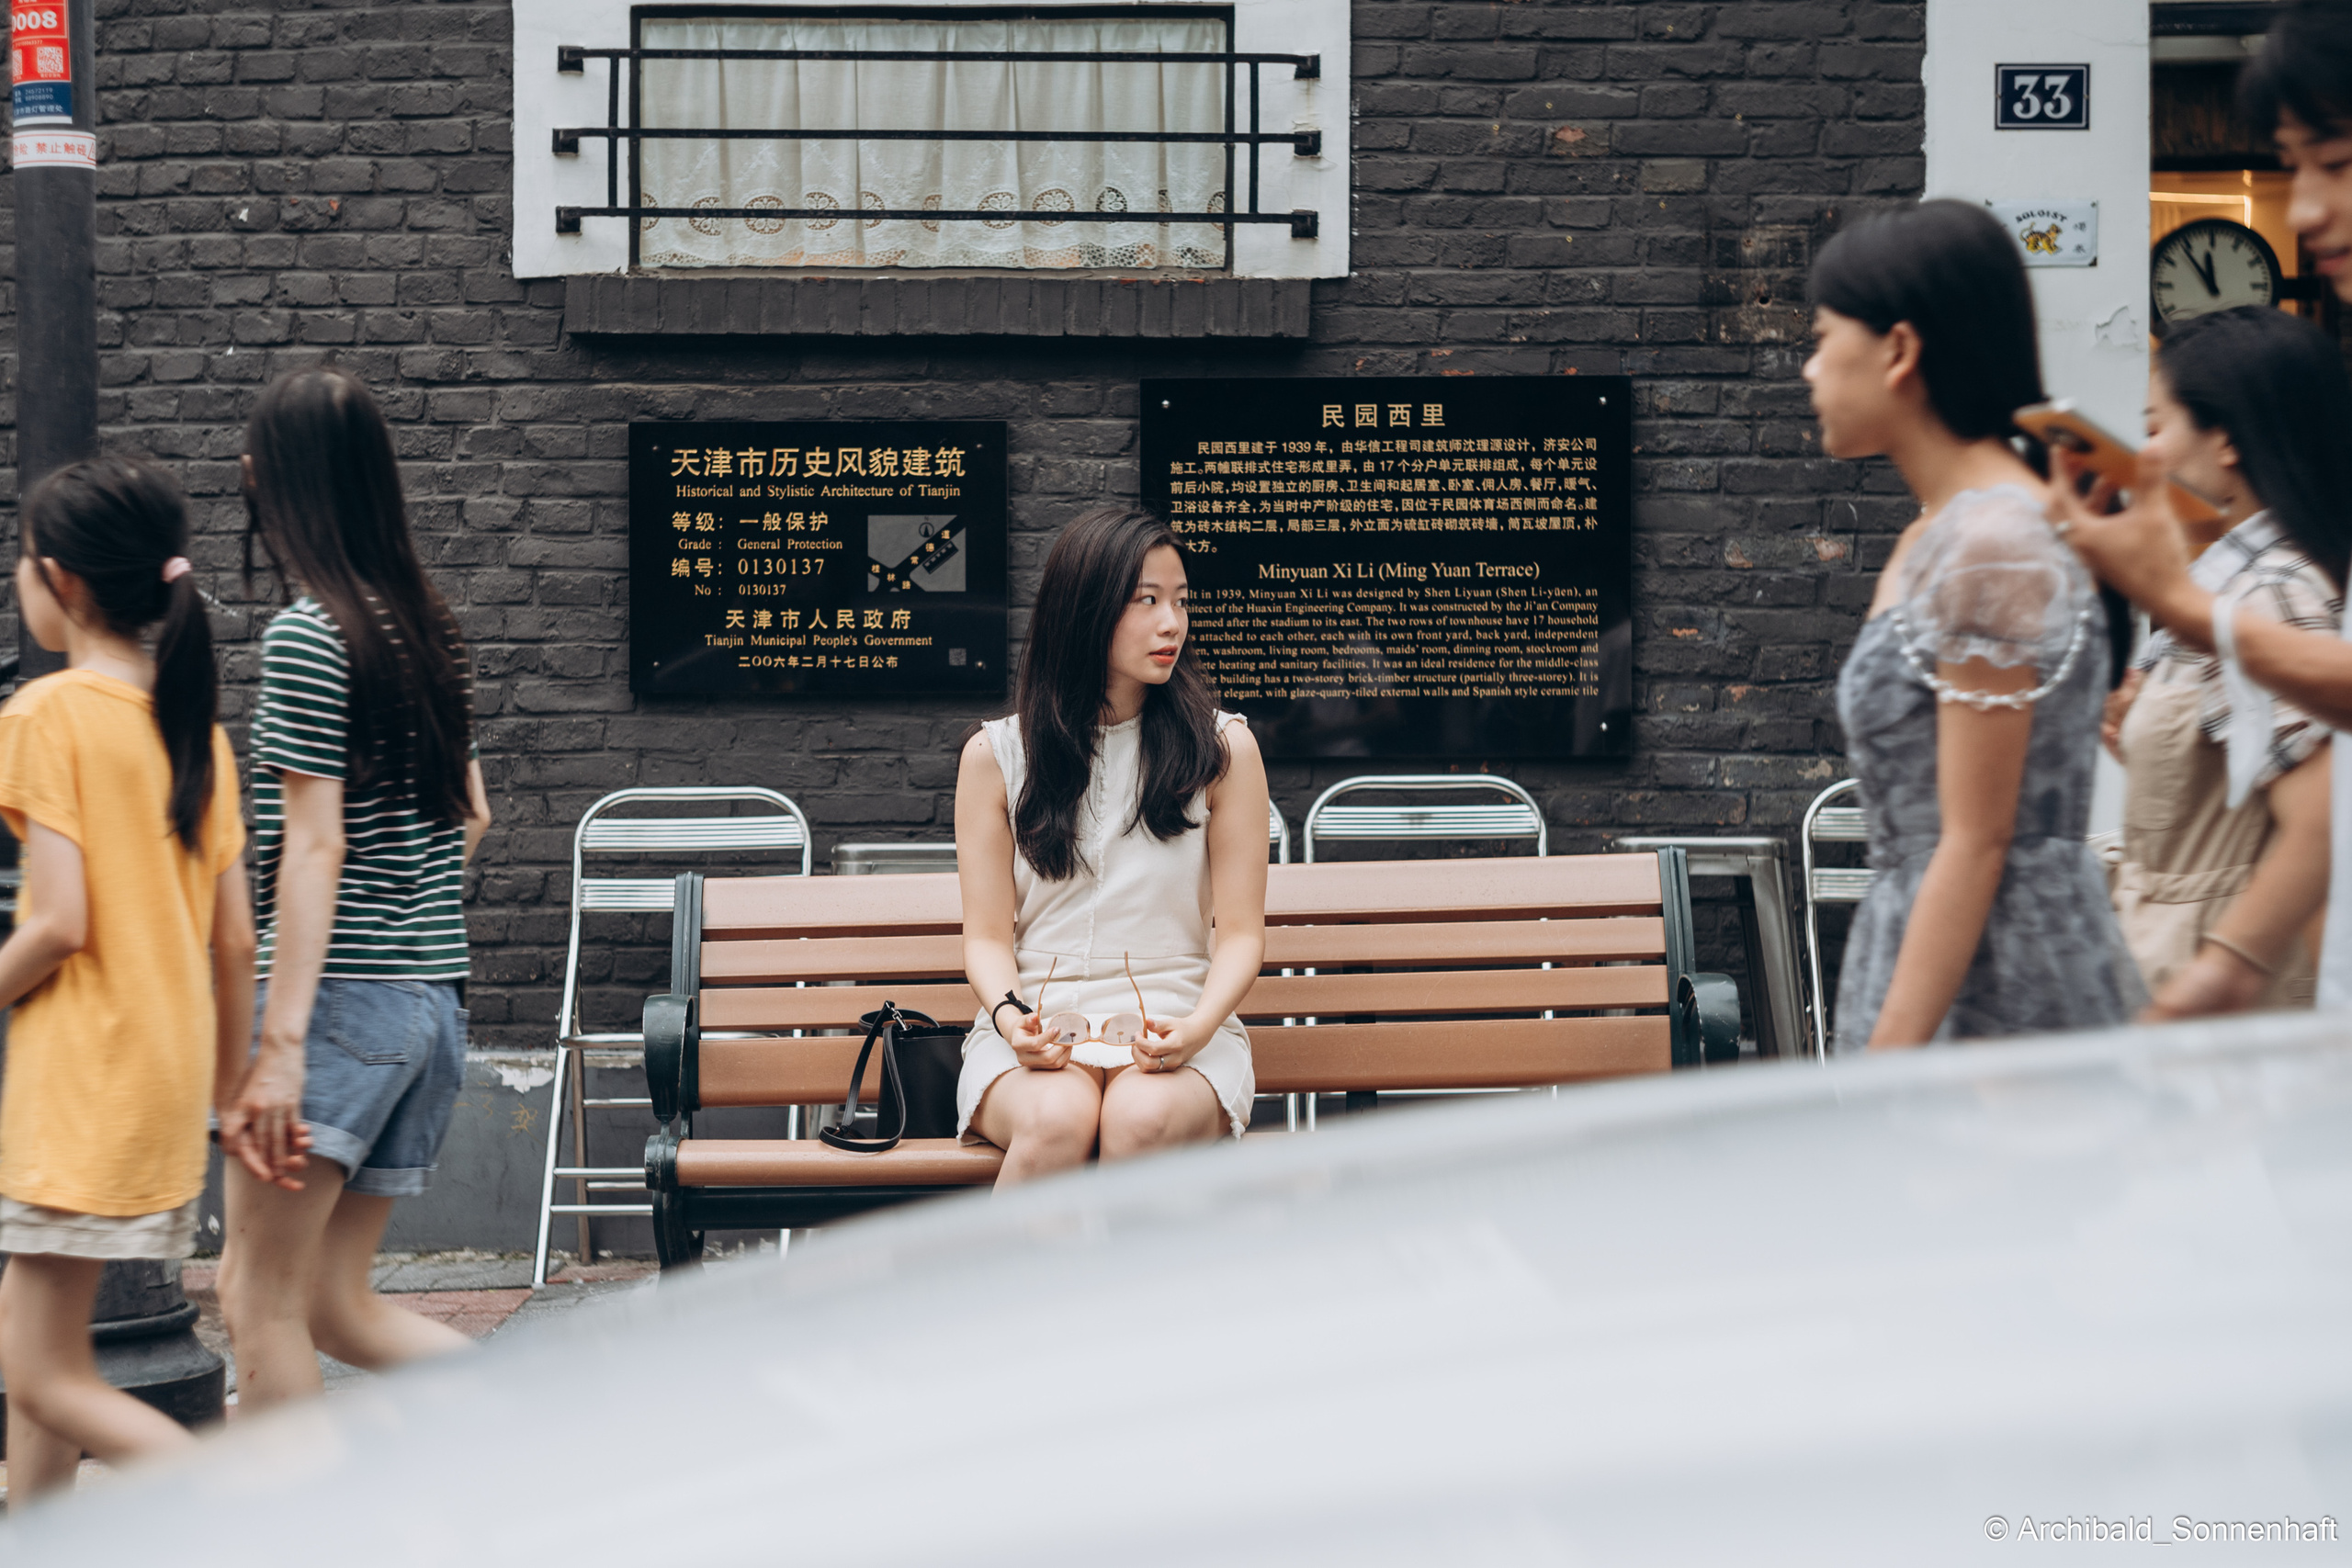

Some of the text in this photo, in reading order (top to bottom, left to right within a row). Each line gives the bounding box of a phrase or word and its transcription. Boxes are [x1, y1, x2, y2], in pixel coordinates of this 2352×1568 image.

[2012, 73, 2073, 120] 33
[2015, 209, 2068, 223] SOLOIST
[1322, 403, 1445, 427] 民园西里
[670, 446, 967, 478] 天津市历史风貌建筑
[676, 484, 961, 500] Historical and Stylistic Architecture of Tianjin
[739, 512, 829, 531] 一般保护
[737, 539, 780, 549] General
[786, 538, 843, 549] Protection
[1185, 539, 1217, 552] 大方。
[738, 558, 824, 574] 0130137
[1259, 561, 1540, 582] Minyuan Xi Li (Ming Yuan Terrace)
[738, 584, 786, 595] 0130137
[1201, 591, 1212, 599] in
[1216, 589, 1245, 599] 1939,
[1249, 589, 1295, 601] Minyuan
[1300, 589, 1313, 599] Xi
[1317, 589, 1329, 598] Li
[1355, 588, 1404, 601] designed
[1408, 588, 1420, 601] by
[1424, 588, 1452, 597] Shen
[1454, 588, 1493, 600] Liyuan
[1496, 587, 1528, 599] (Shen
[1585, 588, 1598, 597] an
[1188, 604, 1213, 613] hitect
[1215, 603, 1227, 613] of
[1228, 604, 1244, 613] the
[1247, 604, 1282, 613] Huaxin
[1284, 603, 1344, 615] Engineering
[1346, 602, 1396, 615] Company.
[1399, 602, 1407, 611] It
[1431, 602, 1488, 612] constructed
[1490, 602, 1502, 614] by
[1506, 602, 1521, 611] the
[1524, 601, 1548, 610] Ji'an
[1551, 601, 1597, 612] Company
[725, 609, 911, 629] 天津市人民政府
[1191, 617, 1224, 626] named
[1227, 617, 1250, 626] after
[1252, 617, 1268, 626] the
[1271, 617, 1310, 627] stadium
[1312, 619, 1323, 627] to
[1340, 618, 1363, 626] east.
[1366, 616, 1385, 626] The
[1387, 617, 1407, 626] two
[1435, 616, 1448, 626] of
[1450, 616, 1504, 626] townhouse
[1506, 615, 1531, 626] have
[1532, 615, 1545, 625] 17
[1547, 615, 1599, 625] household
[704, 635, 933, 648] Tianjin Municipal People's Government
[1199, 631, 1243, 640] attached
[1260, 632, 1284, 641] each
[1287, 632, 1317, 641] other,
[1320, 631, 1345, 641] each
[1348, 630, 1371, 640] with
[1374, 630, 1388, 640] its
[1390, 632, 1414, 640] own
[1417, 629, 1442, 639] front
[1445, 630, 1472, 642] yard,
[1476, 630, 1500, 639] back
[1504, 629, 1531, 642] yard,
[1534, 628, 1599, 640] independent
[1212, 646, 1266, 657] washroom,
[1269, 645, 1298, 658] living
[1332, 645, 1384, 655] bedrooms,
[1421, 646, 1451, 655] room,
[1453, 645, 1491, 656] dinning
[1494, 647, 1523, 655] room,
[1526, 643, 1578, 654] stockroom
[1580, 643, 1599, 652] and
[1218, 660, 1256, 671] heating
[1258, 660, 1277, 669] and
[1280, 660, 1317, 671] sanitary
[1322, 660, 1369, 669] facilities.
[1373, 659, 1380, 667] It
[1420, 658, 1445, 668] ideal
[1448, 659, 1496, 669] residence
[1498, 659, 1514, 668] for
[1516, 658, 1532, 668] the
[1534, 657, 1599, 668] middle-class
[1220, 673, 1261, 685] building
[1263, 673, 1281, 683] has
[1292, 675, 1345, 685] two-storey
[1348, 672, 1411, 683] brick-timber
[1413, 673, 1458, 682] structure
[1459, 672, 1506, 684] (partially
[1508, 671, 1576, 684] three-storey).
[1578, 671, 1588, 681] It
[1590, 672, 1600, 681] is
[1224, 688, 1262, 699] elegant,
[1265, 687, 1287, 696] with
[1290, 687, 1378, 699] glaze-quarry-tiled
[1380, 686, 1420, 697] external
[1423, 686, 1449, 695] walls
[1452, 686, 1470, 695] and
[1473, 686, 1511, 699] Spanish
[1514, 686, 1538, 698] style
[1540, 686, 1579, 696] ceramic
[1582, 686, 1599, 694] tile
